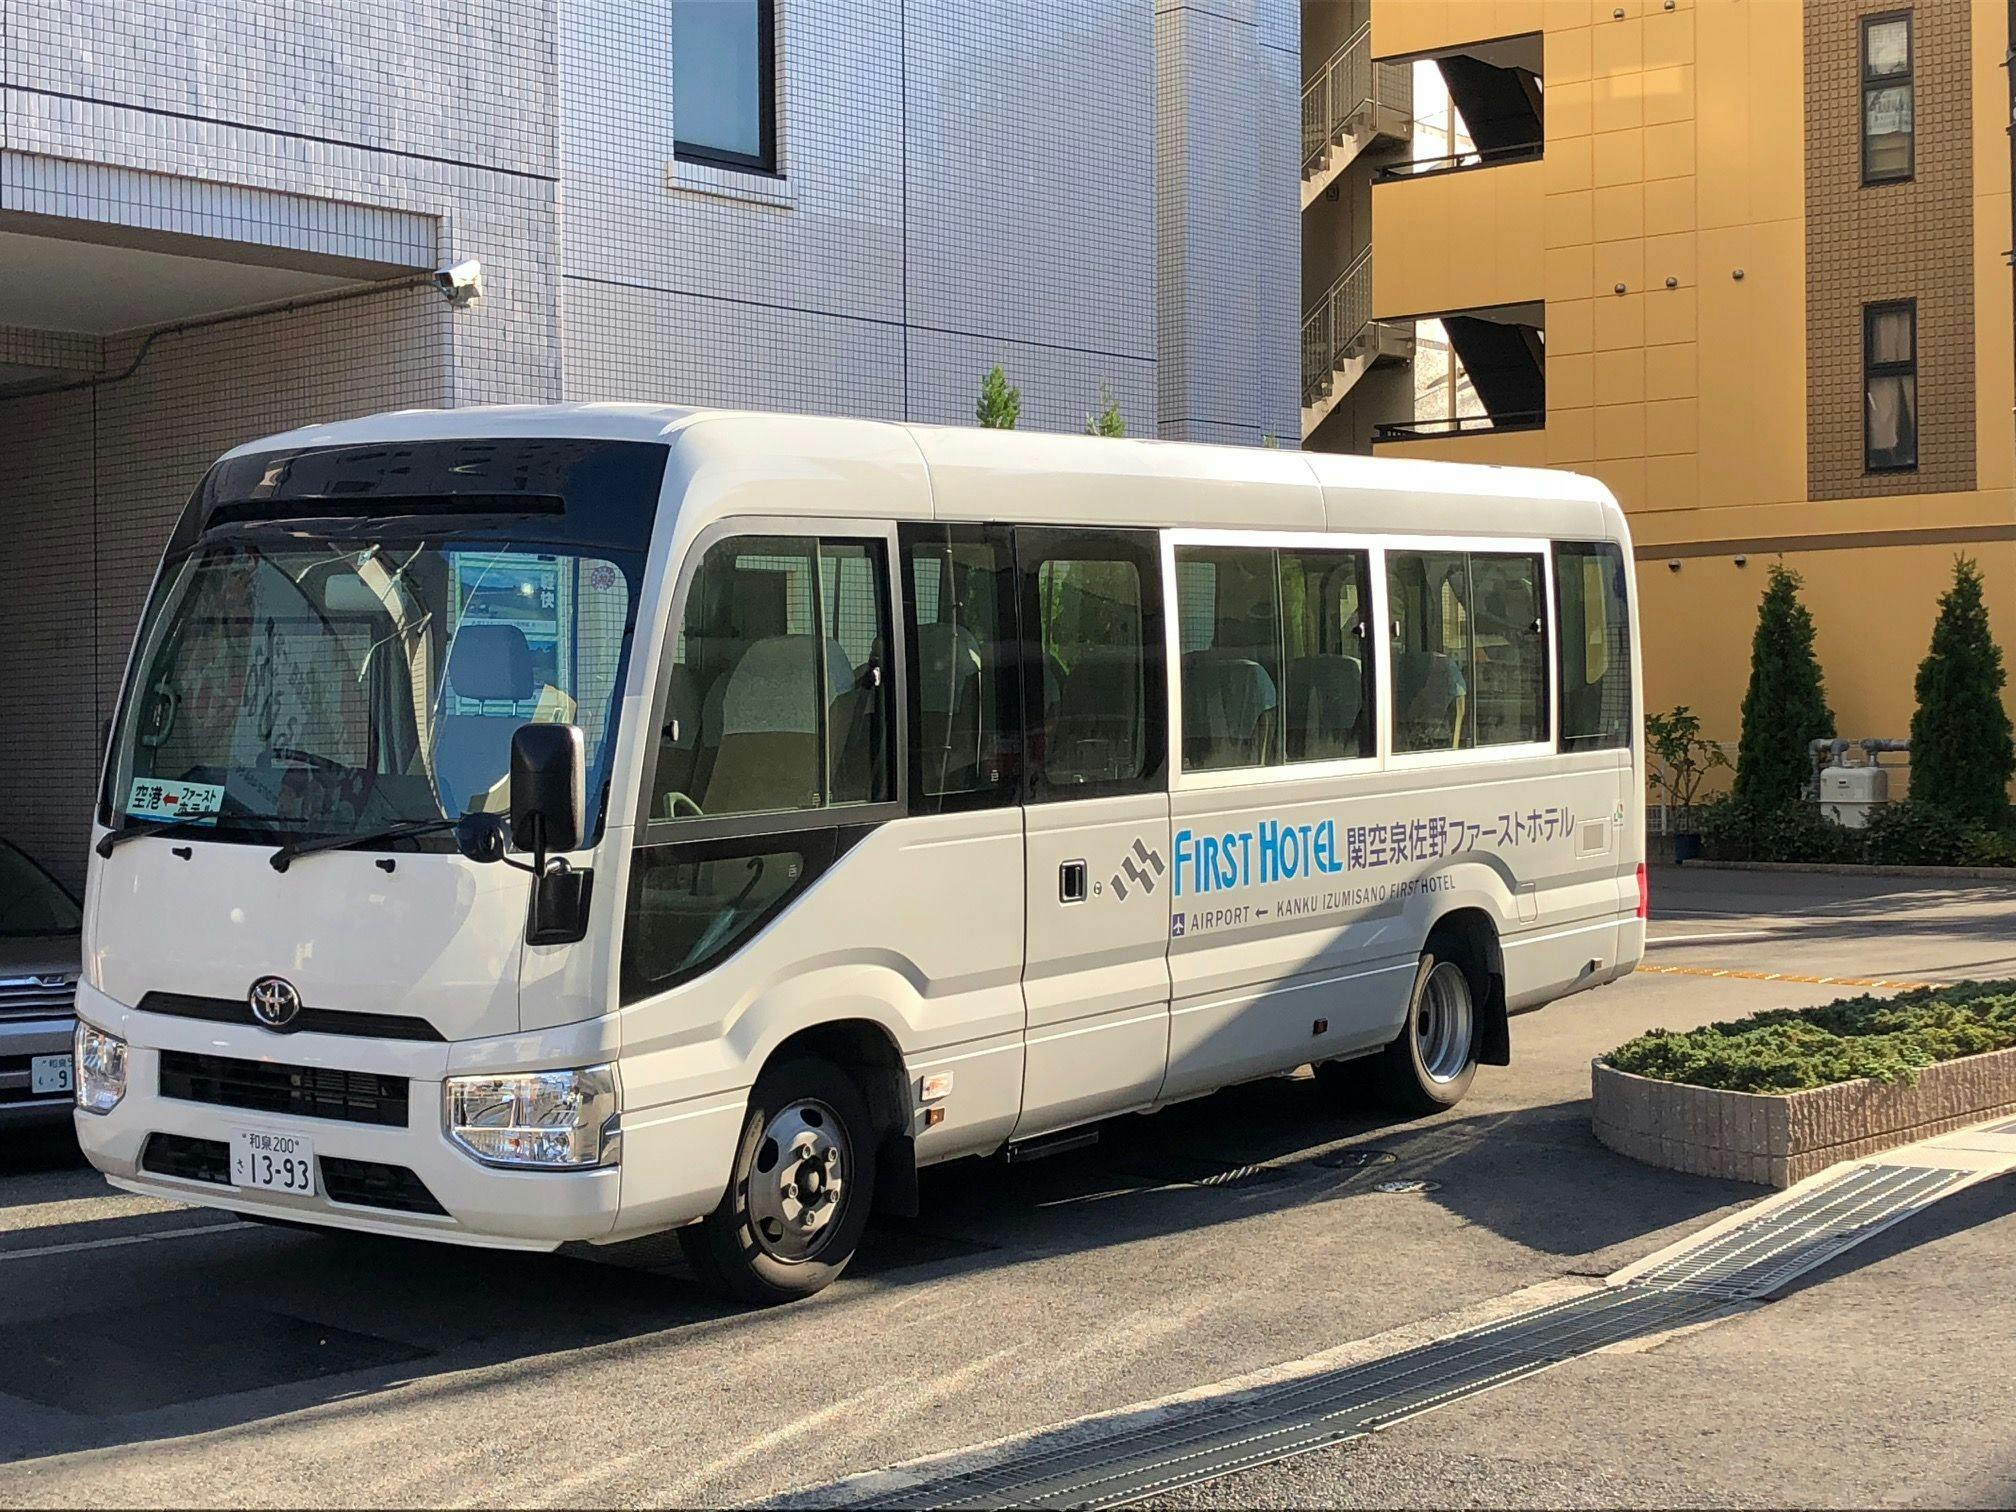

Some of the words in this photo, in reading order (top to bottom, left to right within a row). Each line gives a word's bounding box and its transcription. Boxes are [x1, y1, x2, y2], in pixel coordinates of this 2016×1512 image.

[132, 785, 163, 810] 空港
[181, 787, 216, 803] ファースト
[1174, 829, 1254, 896] FIRST
[1258, 819, 1344, 884] HOTEL
[1346, 806, 1575, 872] 関空泉佐野ファーストホテル
[1191, 906, 1250, 931] AIRPORT
[1277, 895, 1318, 917] KANKU
[1322, 884, 1386, 910] IZUMISANO
[1389, 879, 1420, 899] FIRST
[1420, 874, 1456, 894] HOTEL
[251, 1153, 309, 1190] 13-93
